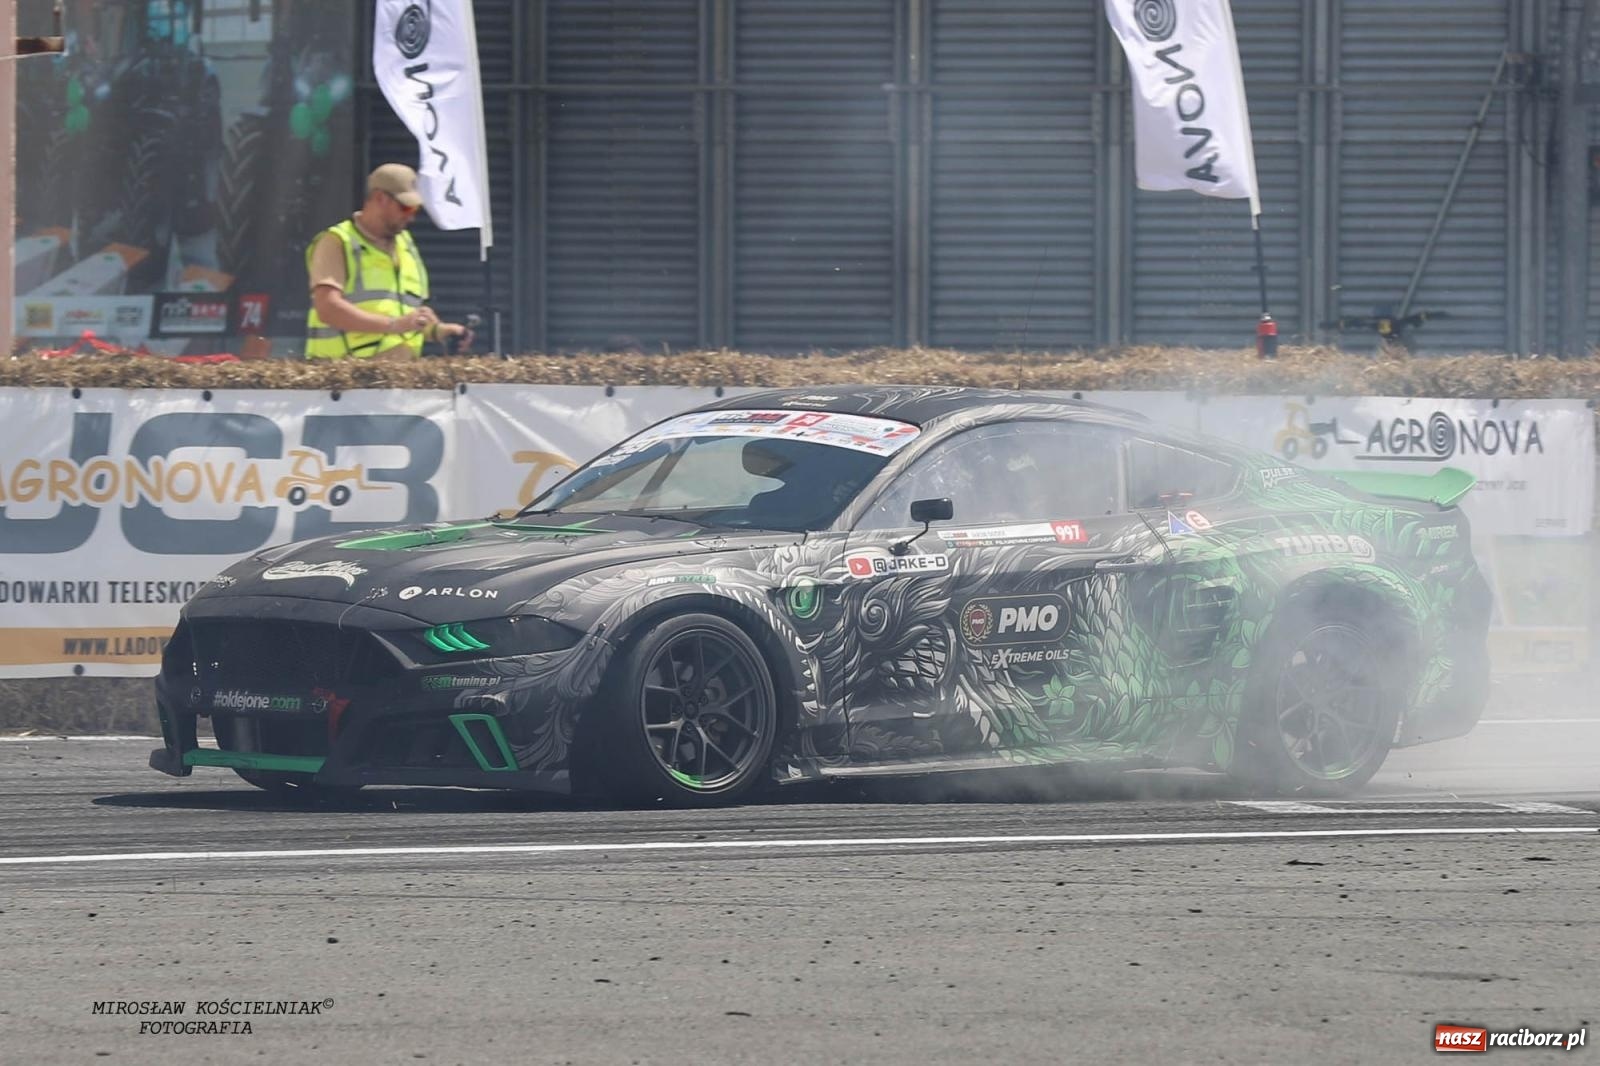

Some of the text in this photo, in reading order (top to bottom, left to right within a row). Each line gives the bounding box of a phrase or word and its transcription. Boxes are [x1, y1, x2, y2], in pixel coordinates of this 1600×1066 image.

[241, 301, 262, 327] 74
[1366, 411, 1543, 455] AGRONOVA
[0, 459, 265, 504] GRONOVA
[1055, 524, 1080, 541] 997
[1275, 535, 1375, 563] TURBO
[873, 557, 946, 573] @JAKE-D
[425, 587, 498, 599] ARLON
[998, 605, 1059, 633] PMO
[1045, 649, 1069, 661] OILS
